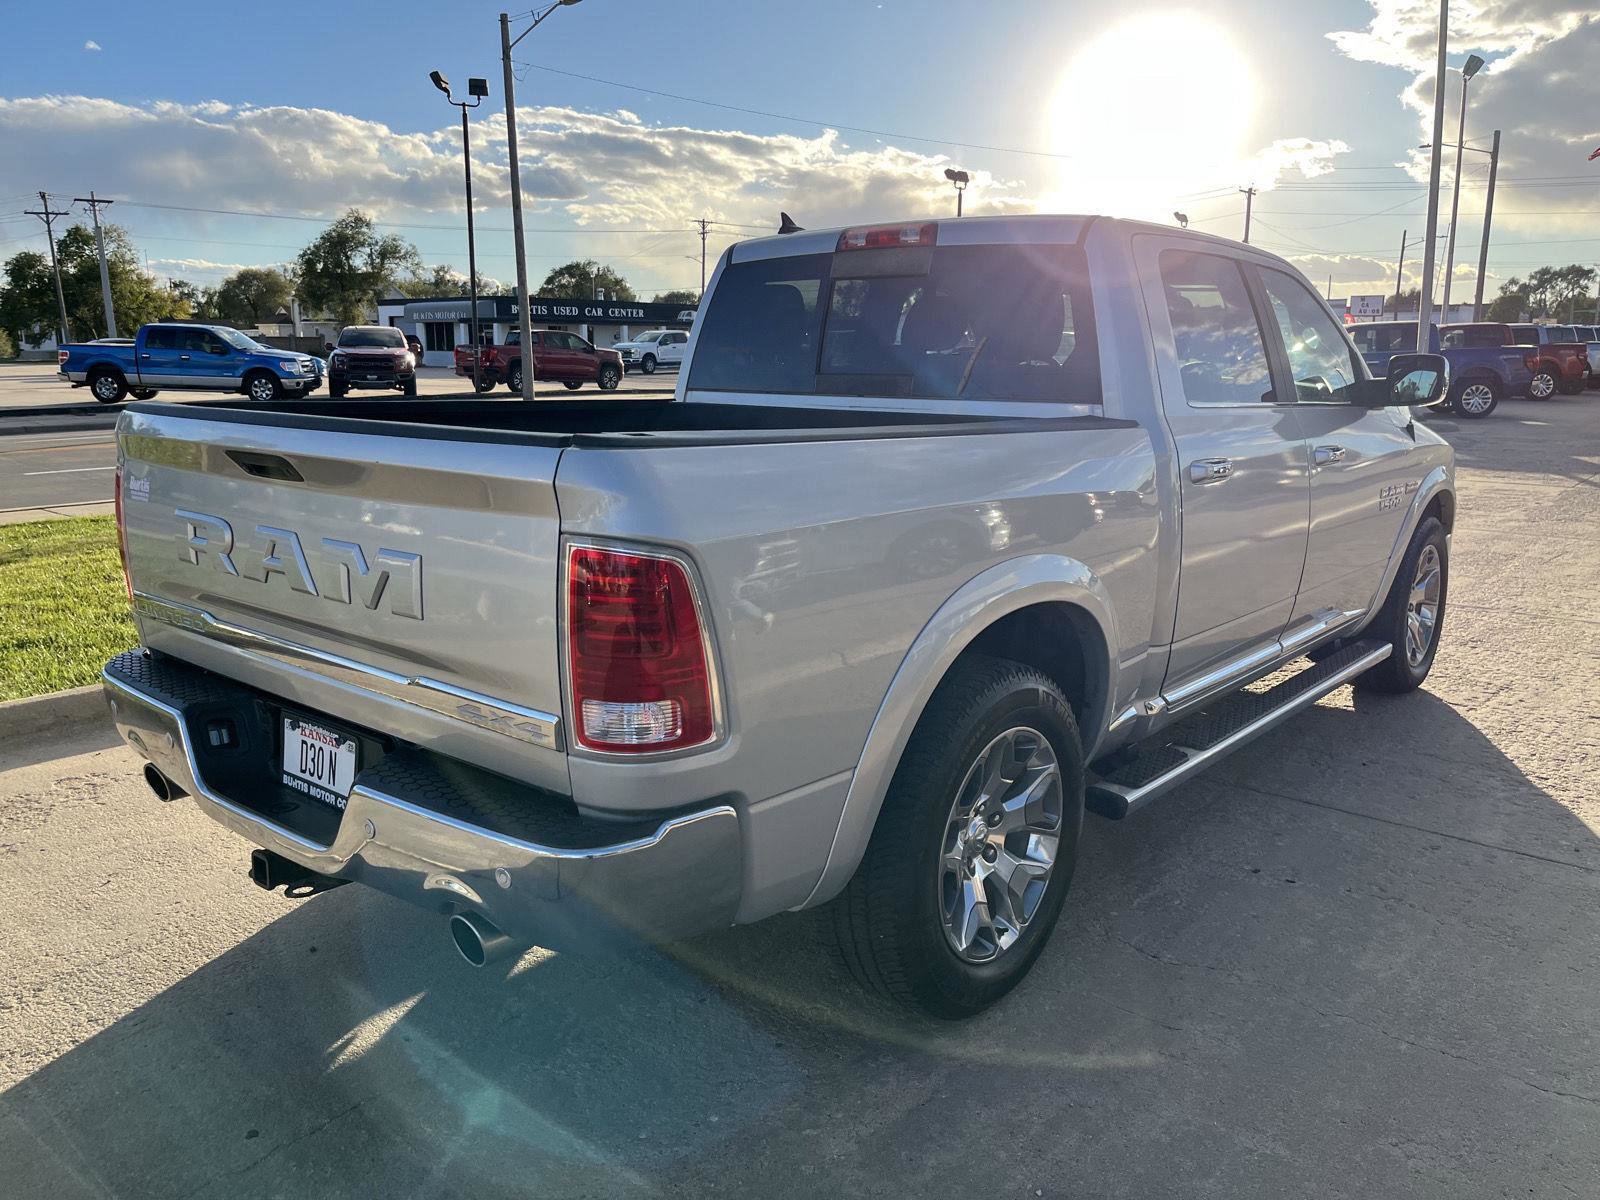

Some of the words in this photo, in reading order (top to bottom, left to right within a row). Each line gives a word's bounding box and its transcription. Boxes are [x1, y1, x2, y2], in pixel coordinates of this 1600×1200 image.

[511, 304, 548, 315] BTIS
[553, 306, 579, 316] USED
[585, 307, 603, 317] CAR
[608, 308, 645, 318] CENTER
[174, 508, 425, 620] RAM
[300, 725, 340, 749] KANSA
[299, 739, 325, 781] D30
[328, 750, 338, 787] N
[283, 773, 309, 793] BURTIS
[309, 786, 336, 806] MOTOR
